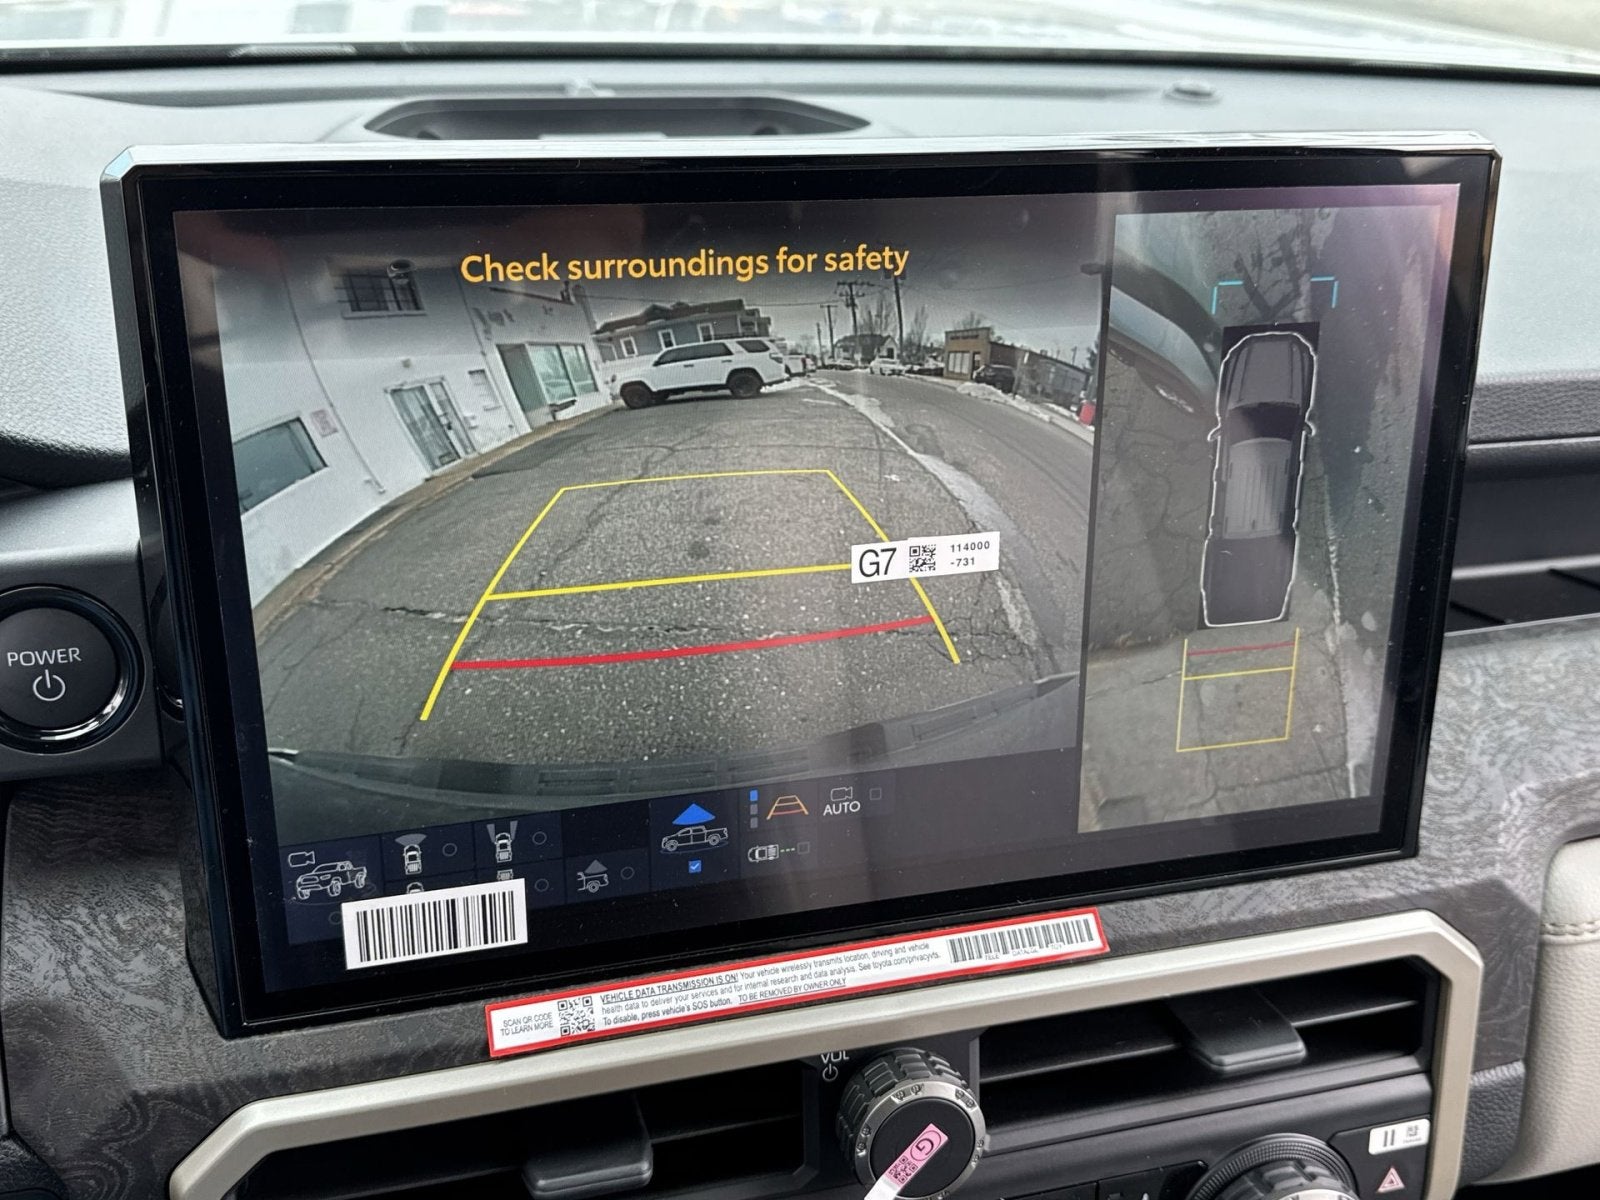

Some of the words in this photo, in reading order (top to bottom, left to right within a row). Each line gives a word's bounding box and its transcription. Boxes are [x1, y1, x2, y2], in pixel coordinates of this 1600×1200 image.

[461, 253, 560, 282] Check
[567, 249, 769, 281] surroundings
[776, 246, 818, 273] for
[824, 244, 910, 276] safety
[950, 540, 991, 553] 114000
[859, 547, 897, 577] G7
[950, 557, 976, 568] -731
[7, 647, 82, 667] POWER
[823, 800, 861, 816] AUTO
[600, 989, 635, 1004] VEHICLE
[635, 985, 657, 1000] DATA
[657, 977, 716, 997] TRANSMISSION
[715, 975, 725, 987] IS
[725, 973, 739, 985] ON!
[740, 972, 756, 980] Your
[757, 966, 781, 976] vehicle
[781, 961, 813, 973] wirelessly
[813, 956, 843, 968] transmits
[844, 952, 871, 963] location,
[871, 948, 894, 958] driving
[894, 945, 907, 955] and
[908, 942, 931, 952] vehicle
[601, 1004, 624, 1015] health
[624, 1001, 640, 1012] data
[641, 1000, 650, 1008] to
[650, 996, 674, 1007] deliver
[674, 994, 690, 1004] your
[691, 988, 719, 999] services
[720, 985, 733, 995] and
[733, 984, 744, 992] for
[744, 978, 770, 990] internal
[770, 974, 799, 986] research
[800, 971, 813, 981] and
[813, 969, 829, 979] data
[858, 962, 872, 971] See
[603, 1016, 613, 1026] To
[612, 1012, 641, 1024] disable,
[641, 1009, 661, 1021] press
[661, 1002, 691, 1015] vehicle's
[692, 1000, 709, 1011] SOS
[709, 997, 733, 1008] button.
[738, 994, 749, 1003] TO
[748, 992, 759, 1002] BE
[759, 986, 794, 1000] REMOVED
[793, 984, 804, 993] BY
[803, 979, 830, 993] OWNER
[829, 977, 847, 988] ONLY
[501, 1027, 511, 1037] TO
[511, 1024, 533, 1035] LEARN
[533, 1020, 554, 1031] MORE
[503, 1017, 522, 1028] SCAN
[533, 1012, 553, 1022] CODE
[820, 1050, 850, 1064] VOL
[915, 1138, 935, 1156] G
